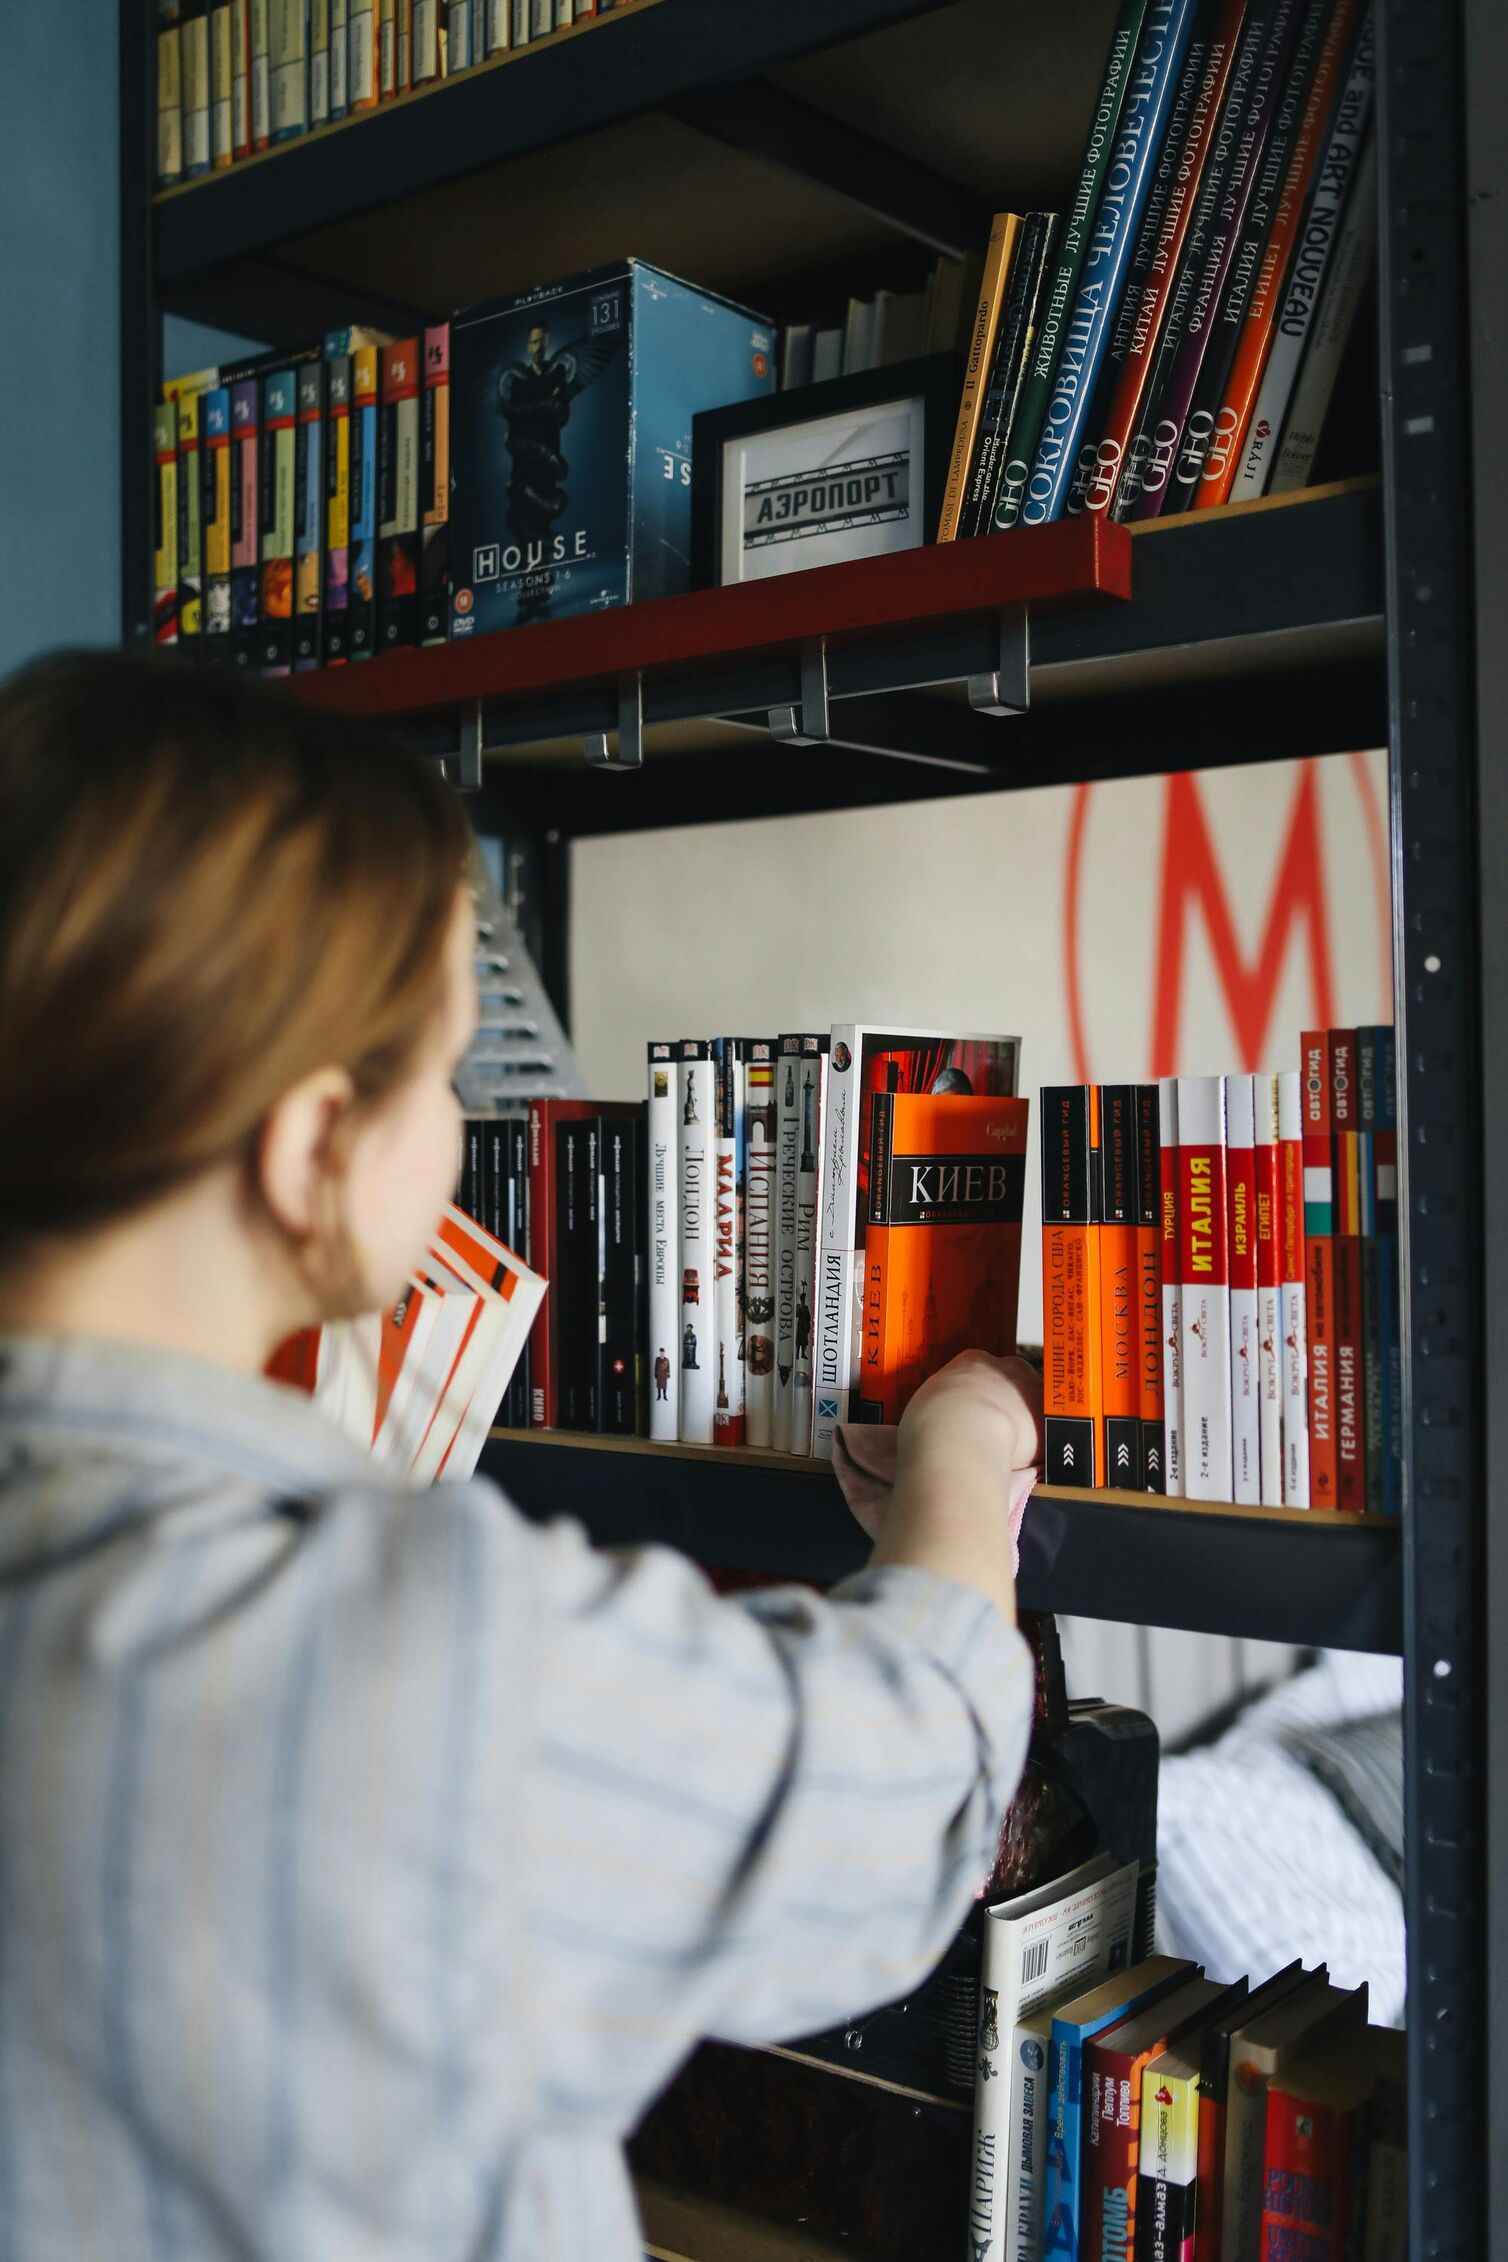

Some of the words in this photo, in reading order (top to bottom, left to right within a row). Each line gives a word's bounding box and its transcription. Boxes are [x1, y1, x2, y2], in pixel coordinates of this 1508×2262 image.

[1336, 89, 1366, 135] and
[1162, 269, 1195, 349] ИТАЛИЯ
[1191, 166, 1225, 254] ЛУЧШИЕ
[1215, 21, 1265, 160] ФОТОГРАФИИ
[1189, 235, 1226, 334] ФРАНЦИЯ
[1220, 125, 1257, 222] ЛУЧШИЕ
[1247, 0, 1293, 125] ФОТОГРАФИ
[1223, 240, 1259, 324] ИТАЛИЯ
[1251, 135, 1289, 227] ЛУЧШИЕ
[1278, 0, 1326, 130] ФОТОГРАФИ
[1249, 243, 1282, 320] ЕГИПЕТ
[1275, 137, 1311, 227] ЛУЧШИЕ
[1302, 0, 1350, 130] ФОТОГРАФИ
[1319, 142, 1353, 201] ART
[1034, 266, 1073, 378] ЖИВОТНЫЕ
[1066, 168, 1097, 253] ЛУЧШИЕ
[1087, 29, 1131, 164] ФОТОГРАФИИ
[1112, 283, 1140, 361] АНГЛИЯ
[1135, 184, 1169, 271] ЛУЧШИЕ
[1157, 42, 1205, 178] ФОТОГРАФИИ
[1130, 287, 1160, 356] КИТАЙ
[1153, 186, 1186, 274] ЛУЧШИЕ
[1177, 43, 1226, 182] ФОТОГРАФИИ
[1022, 280, 1103, 525] СОКРОВИЩА
[1087, 0, 1175, 267] ЧЕЛОВЕЧЕСТ
[1280, 208, 1336, 338] NOUVEAU
[592, 299, 619, 326] 131
[969, 300, 989, 374] Gattopardo
[951, 419, 968, 484] LAMPEDUSA
[979, 436, 993, 467] Orient
[986, 436, 1001, 473] Murder
[1067, 444, 1100, 515] GEO
[1085, 438, 1122, 511] GEO
[1141, 419, 1178, 493] GEO
[1176, 410, 1215, 485] GEO
[1200, 406, 1239, 482] GEO
[757, 471, 899, 524] АЭРОПОРТ
[949, 485, 957, 499] DI
[971, 468, 987, 503] Express
[995, 459, 1029, 529] GEO
[473, 530, 587, 583] HOUSE
[496, 570, 551, 594] SEASONS
[555, 568, 572, 580] 1-6
[1307, 1048, 1322, 1121] автогид
[1333, 1046, 1349, 1119] автогид
[908, 1165, 1007, 1204] КИЕВ
[1164, 1192, 1175, 1241] ТУРЦИЯ
[1191, 1157, 1213, 1272] ИТАЛИЯ
[1234, 1182, 1247, 1256] ИЗРАИЛЬ
[1258, 1191, 1271, 1241] ЕГИПЕТ
[1052, 1230, 1064, 1268] США
[1075, 1238, 1084, 1322] САН-ФРАНЦИСКО
[1311, 1246, 1324, 1319] автомобиле
[822, 1255, 842, 1384] ШОТЛАНДИЯ
[868, 1264, 882, 1367] КИЕВ
[1052, 1274, 1065, 1336] ГОРОДА
[1115, 1265, 1129, 1379] МОСКВА
[1144, 1250, 1160, 1397] ЛОНДОН
[532, 1388, 545, 1422] КИНО
[1053, 1340, 1065, 1411] ЛУЧШИЕ
[1312, 1344, 1330, 1440] ИТАЛИЯ
[1339, 1345, 1357, 1461] ГЕРМАНИЯ
[1169, 1429, 1179, 1465] издание
[1200, 1416, 1209, 1457] издание
[1200, 1461, 1209, 1479] 2-е
[1169, 1466, 1179, 1480] 2-е
[1024, 2076, 1035, 2112] ЗАВЕСА
[1056, 2040, 1069, 2106] действовать
[1102, 2076, 1116, 2121] Пеплум
[1117, 2079, 1131, 2127] Топливо
[1021, 2112, 1034, 2174] ДЫМОВАЯ
[1054, 2107, 1065, 2140] Время
[1090, 2071, 1101, 2147] Катилинарии
[1102, 2186, 1129, 2262] ОТОМБ
